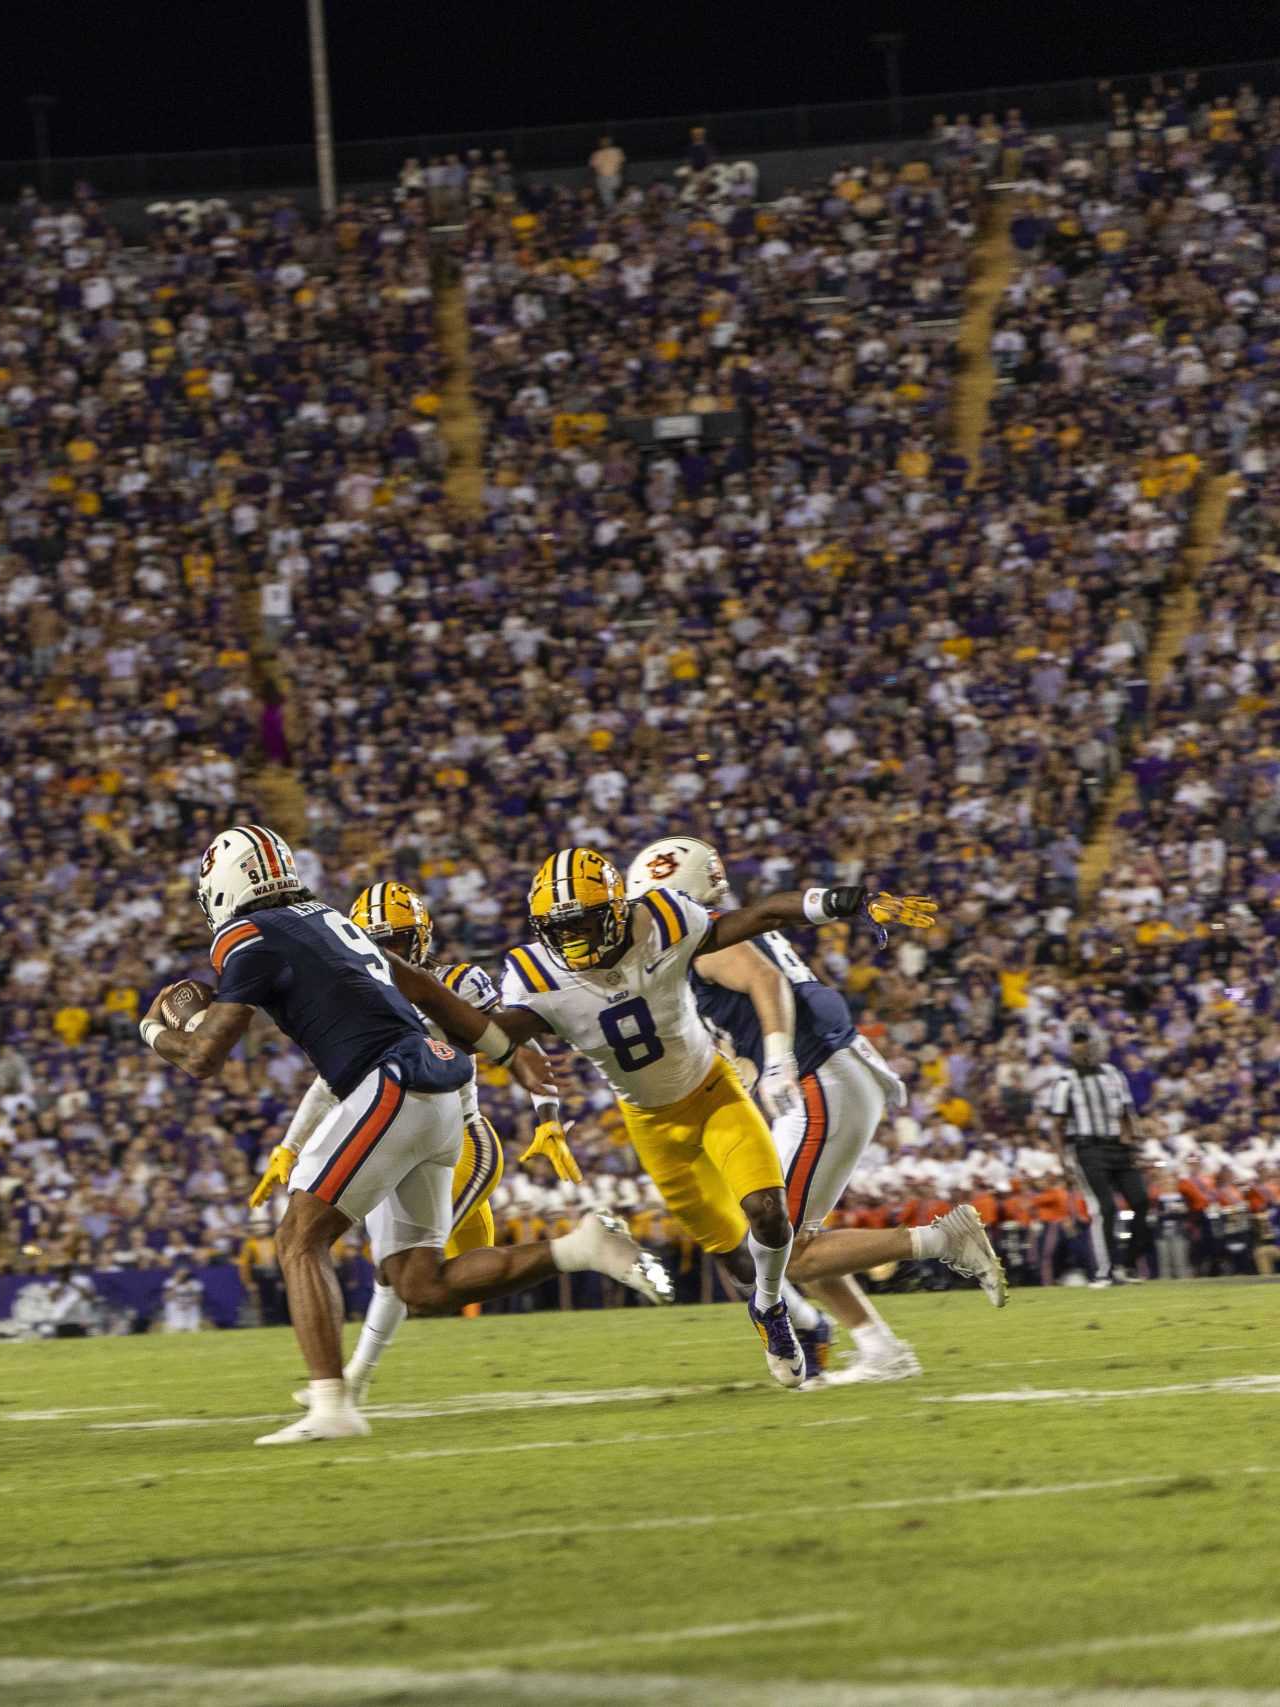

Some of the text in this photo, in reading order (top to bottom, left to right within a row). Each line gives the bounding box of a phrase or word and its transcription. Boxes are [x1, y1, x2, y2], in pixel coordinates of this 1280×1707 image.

[247, 869, 261, 885] 9
[253, 884, 276, 897] WAR
[322, 910, 395, 987] 9
[598, 995, 665, 1073] 8
